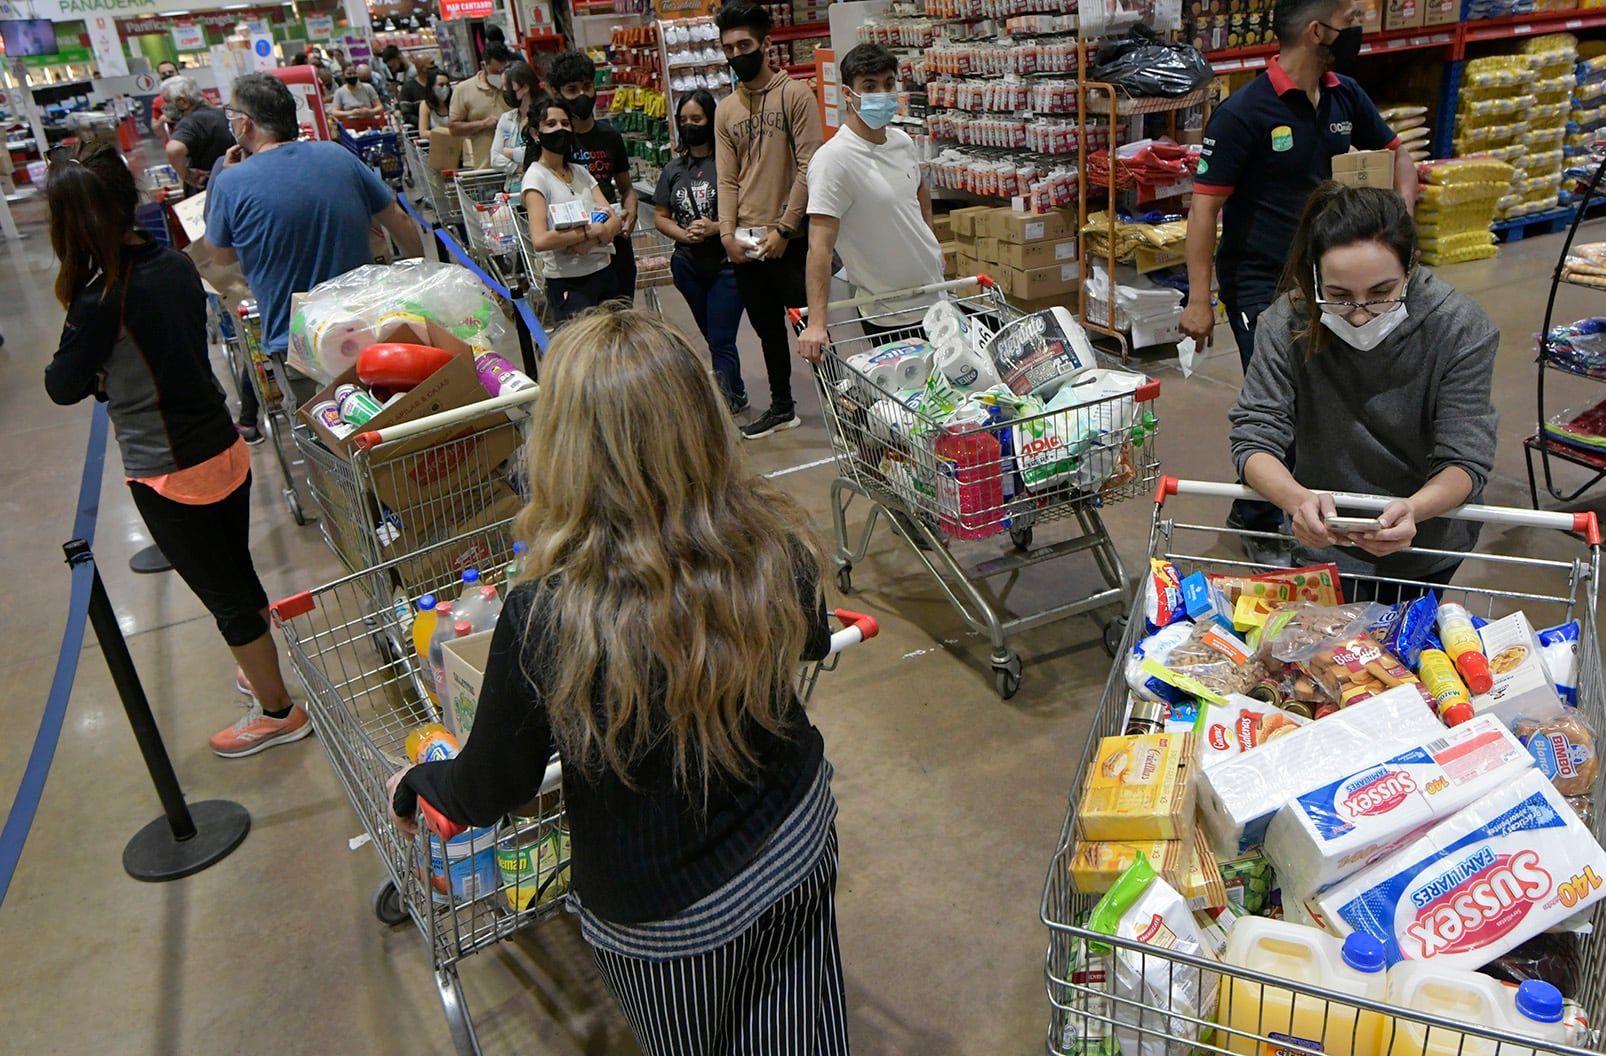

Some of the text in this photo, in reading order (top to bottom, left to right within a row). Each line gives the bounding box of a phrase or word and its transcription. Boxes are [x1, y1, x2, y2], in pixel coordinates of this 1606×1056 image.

[997, 314, 1047, 363] Elegante
[1551, 735, 1572, 776] BIMBO
[1343, 770, 1418, 818] Sussex
[1345, 767, 1391, 793] FAMILIARES
[1425, 776, 1450, 796] 140
[1410, 845, 1498, 908] FAMILIARES
[1557, 864, 1604, 909] 140
[1407, 849, 1553, 959] Sussex
[1495, 908, 1523, 928] Servilletas
